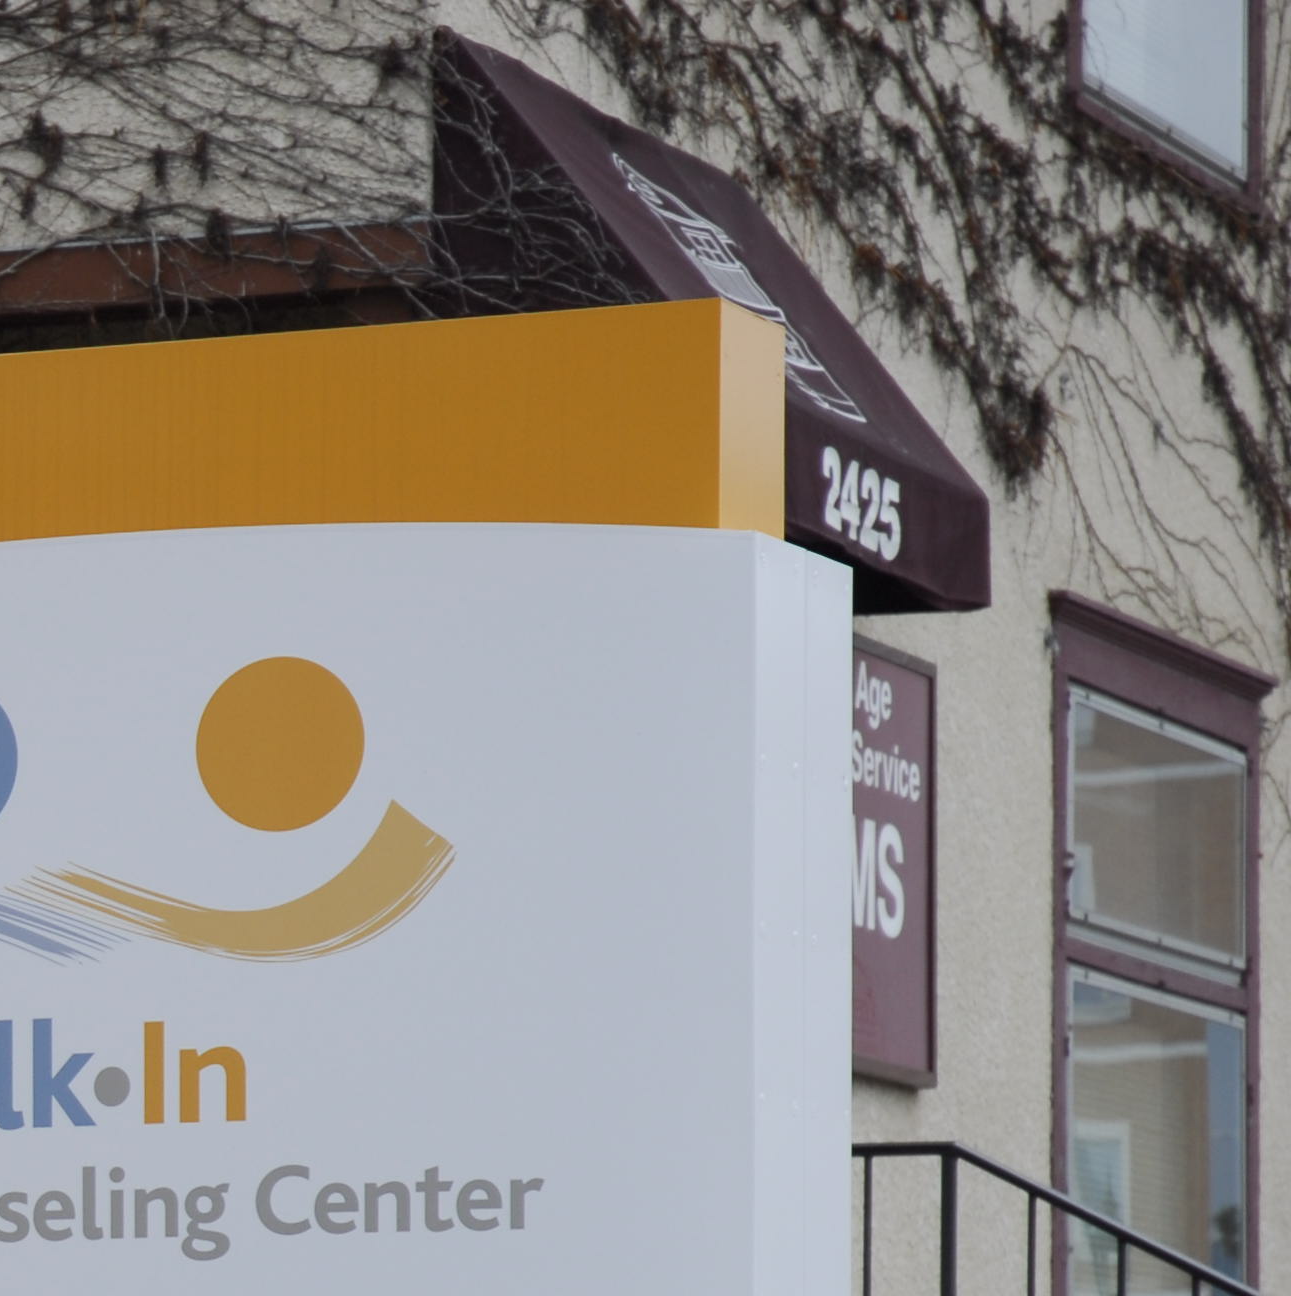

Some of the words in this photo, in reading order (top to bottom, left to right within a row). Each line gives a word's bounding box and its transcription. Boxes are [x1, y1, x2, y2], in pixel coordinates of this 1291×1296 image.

[822, 447, 901, 561] 2425
[855, 660, 893, 730] Age
[853, 729, 921, 802] Service
[255, 1165, 545, 1236] Center
